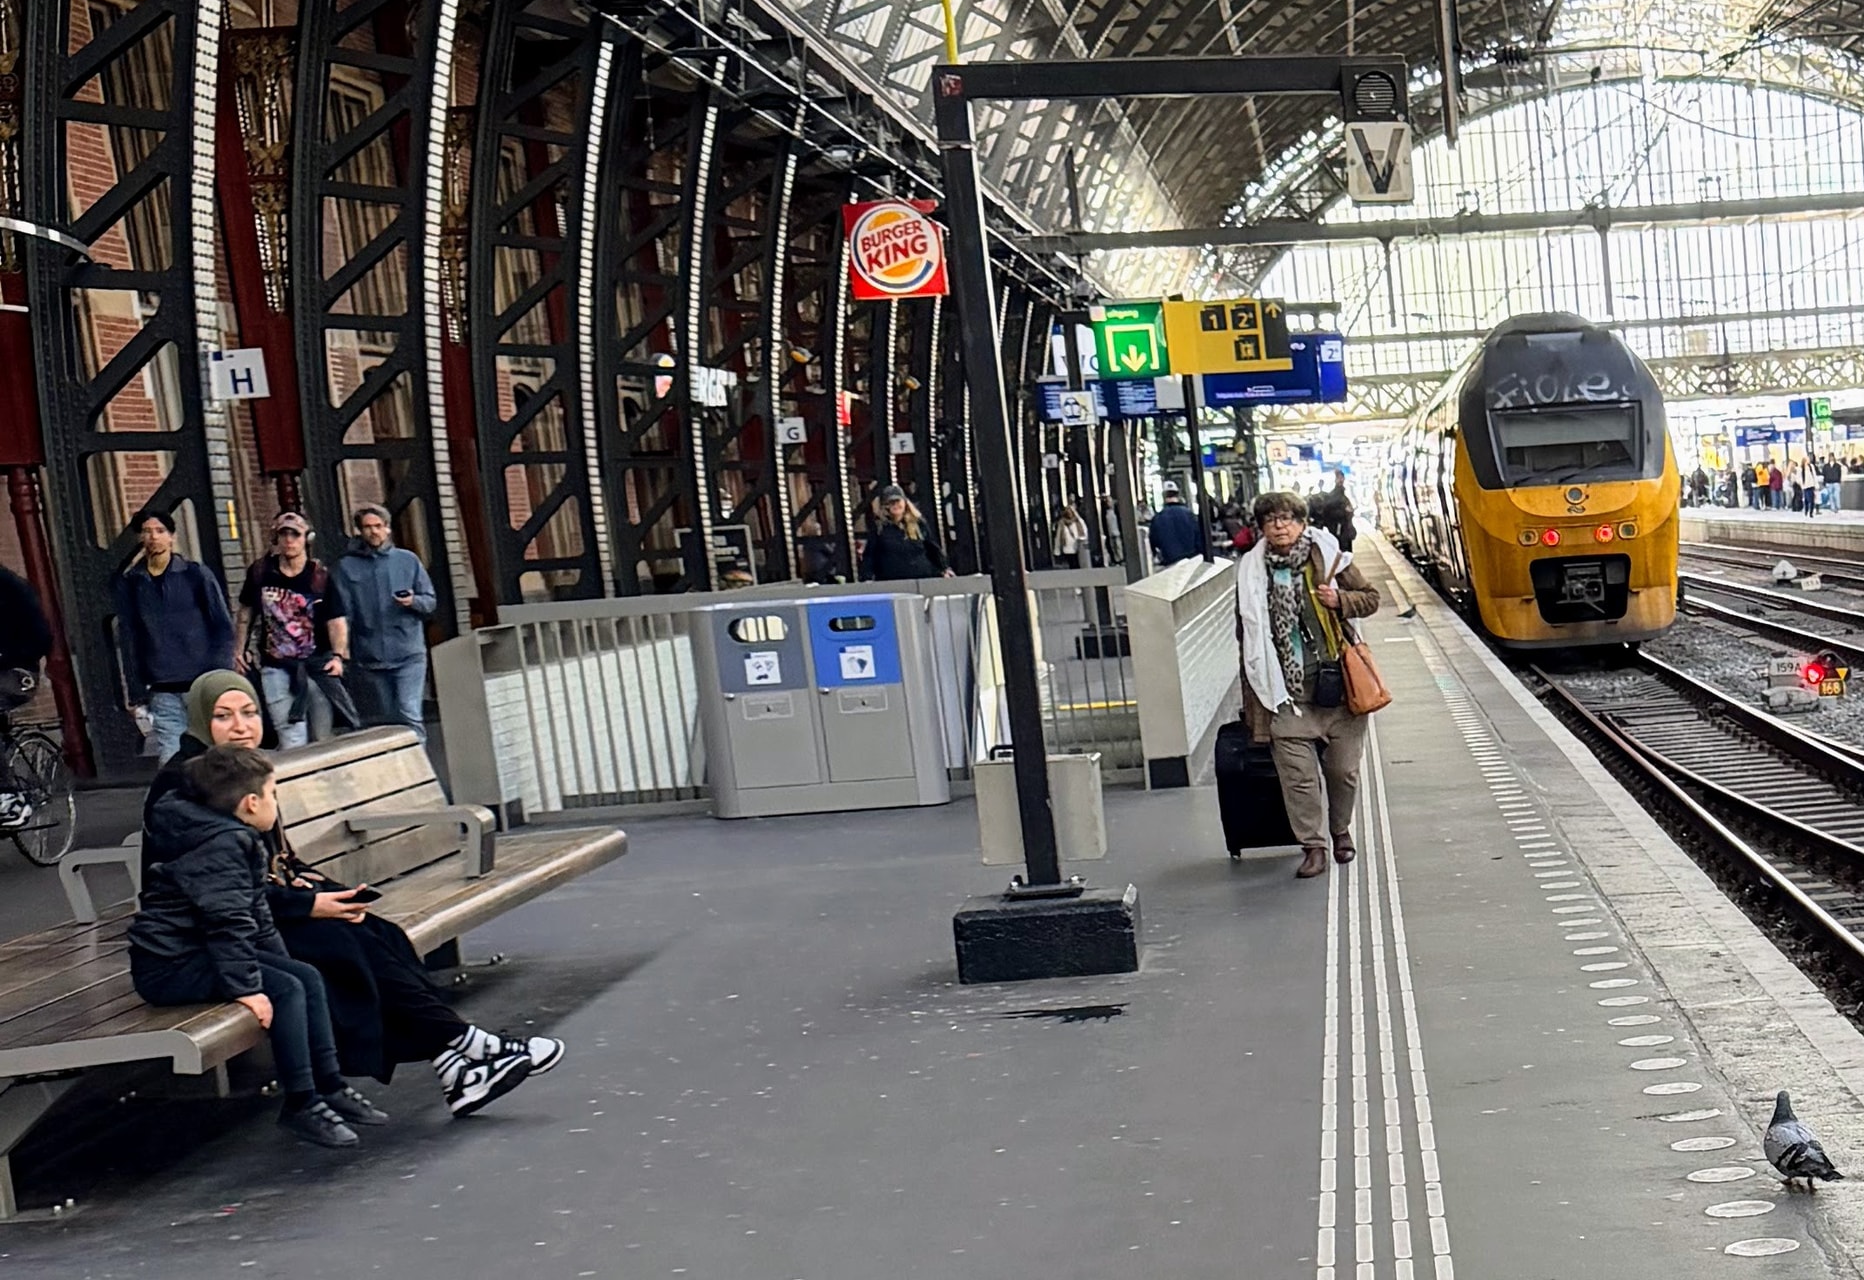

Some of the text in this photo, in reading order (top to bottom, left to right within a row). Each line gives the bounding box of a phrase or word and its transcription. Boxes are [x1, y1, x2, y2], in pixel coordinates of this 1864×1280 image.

[1350, 128, 1405, 194] V
[861, 219, 924, 254] BURGER
[866, 234, 929, 274] KING
[1208, 313, 1219, 330] 1
[230, 367, 254, 394] H
[786, 426, 800, 441] G
[1821, 680, 1840, 695] 168
